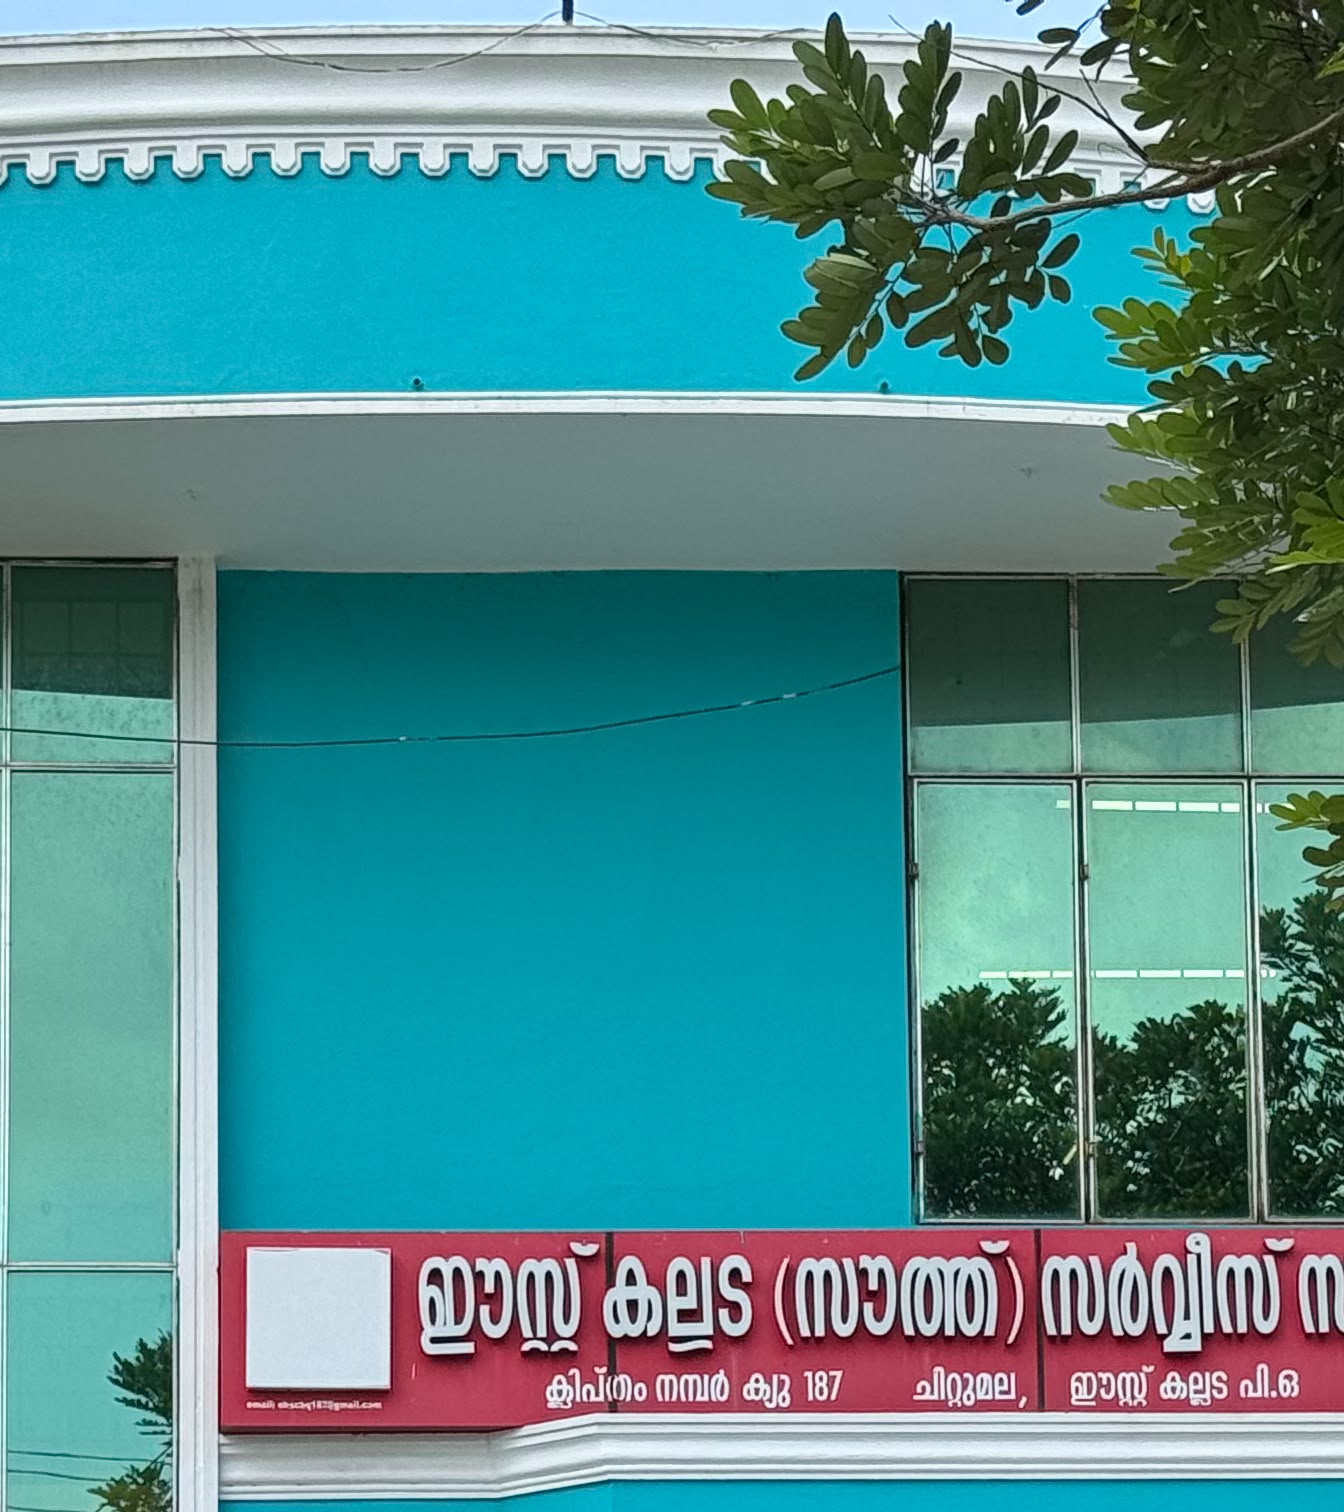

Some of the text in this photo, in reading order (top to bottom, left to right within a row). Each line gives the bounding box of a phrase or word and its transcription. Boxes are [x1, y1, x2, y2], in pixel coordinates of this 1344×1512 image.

[418, 1241, 600, 1355] ഈസ്റ്റ്
[603, 1254, 753, 1353] കല്ലട
[774, 1240, 1024, 1345] (സൗത്ത്)
[1041, 1232, 1295, 1352] സർവ്വീസ്
[655, 1369, 730, 1402] നമ്പർ
[803, 1370, 844, 1402] 187
[1070, 1364, 1155, 1407] ഈസ്റ്റ്
[1159, 1370, 1229, 1406] കല്ലട
